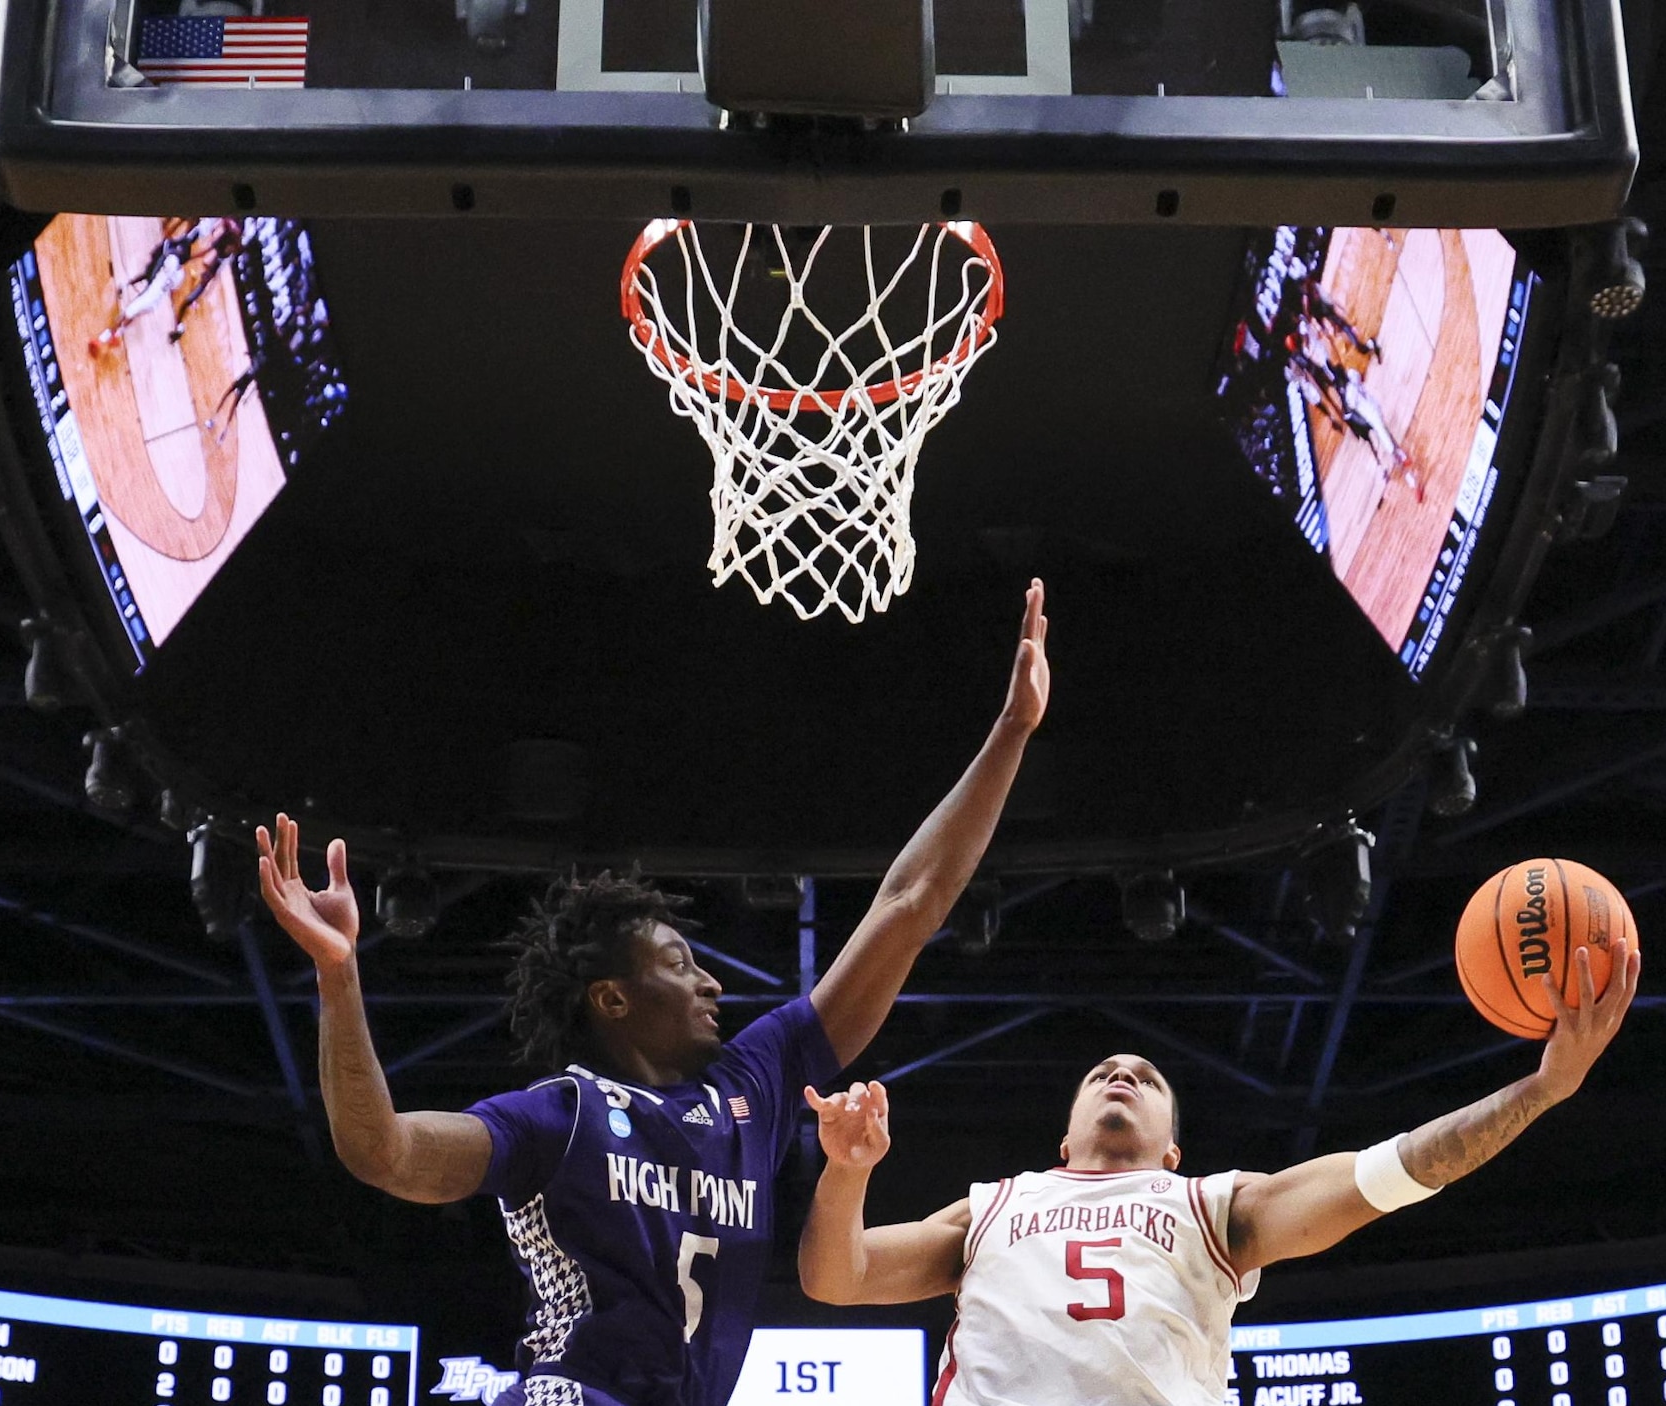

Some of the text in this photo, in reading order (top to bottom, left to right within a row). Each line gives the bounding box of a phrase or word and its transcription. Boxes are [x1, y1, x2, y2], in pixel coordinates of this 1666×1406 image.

[1516, 867, 1551, 980] Wilson
[607, 1153, 757, 1230] HIGH POINT
[1008, 1203, 1176, 1253] RAZORBACKS
[677, 1232, 719, 1344] 5
[1066, 1237, 1125, 1321] 5
[151, 1313, 188, 1335] PTS
[207, 1316, 244, 1338] REB
[262, 1321, 298, 1343] AST
[317, 1324, 353, 1345] BLK
[366, 1326, 399, 1348] FLS
[1236, 1329, 1280, 1347] AYER
[1482, 1308, 1518, 1330] PTS
[1536, 1302, 1573, 1324] REB
[1592, 1295, 1627, 1317] AST
[158, 1340, 178, 1365] 0
[213, 1345, 233, 1370] 0
[1252, 1351, 1350, 1378] THOMAS
[1493, 1336, 1511, 1360] 0
[1548, 1330, 1567, 1354] 0
[1603, 1323, 1622, 1347] 0
[156, 1372, 175, 1398] 2
[775, 1361, 842, 1393] 1ST
[1328, 1381, 1363, 1406] JR.
[1495, 1368, 1514, 1391] 0
